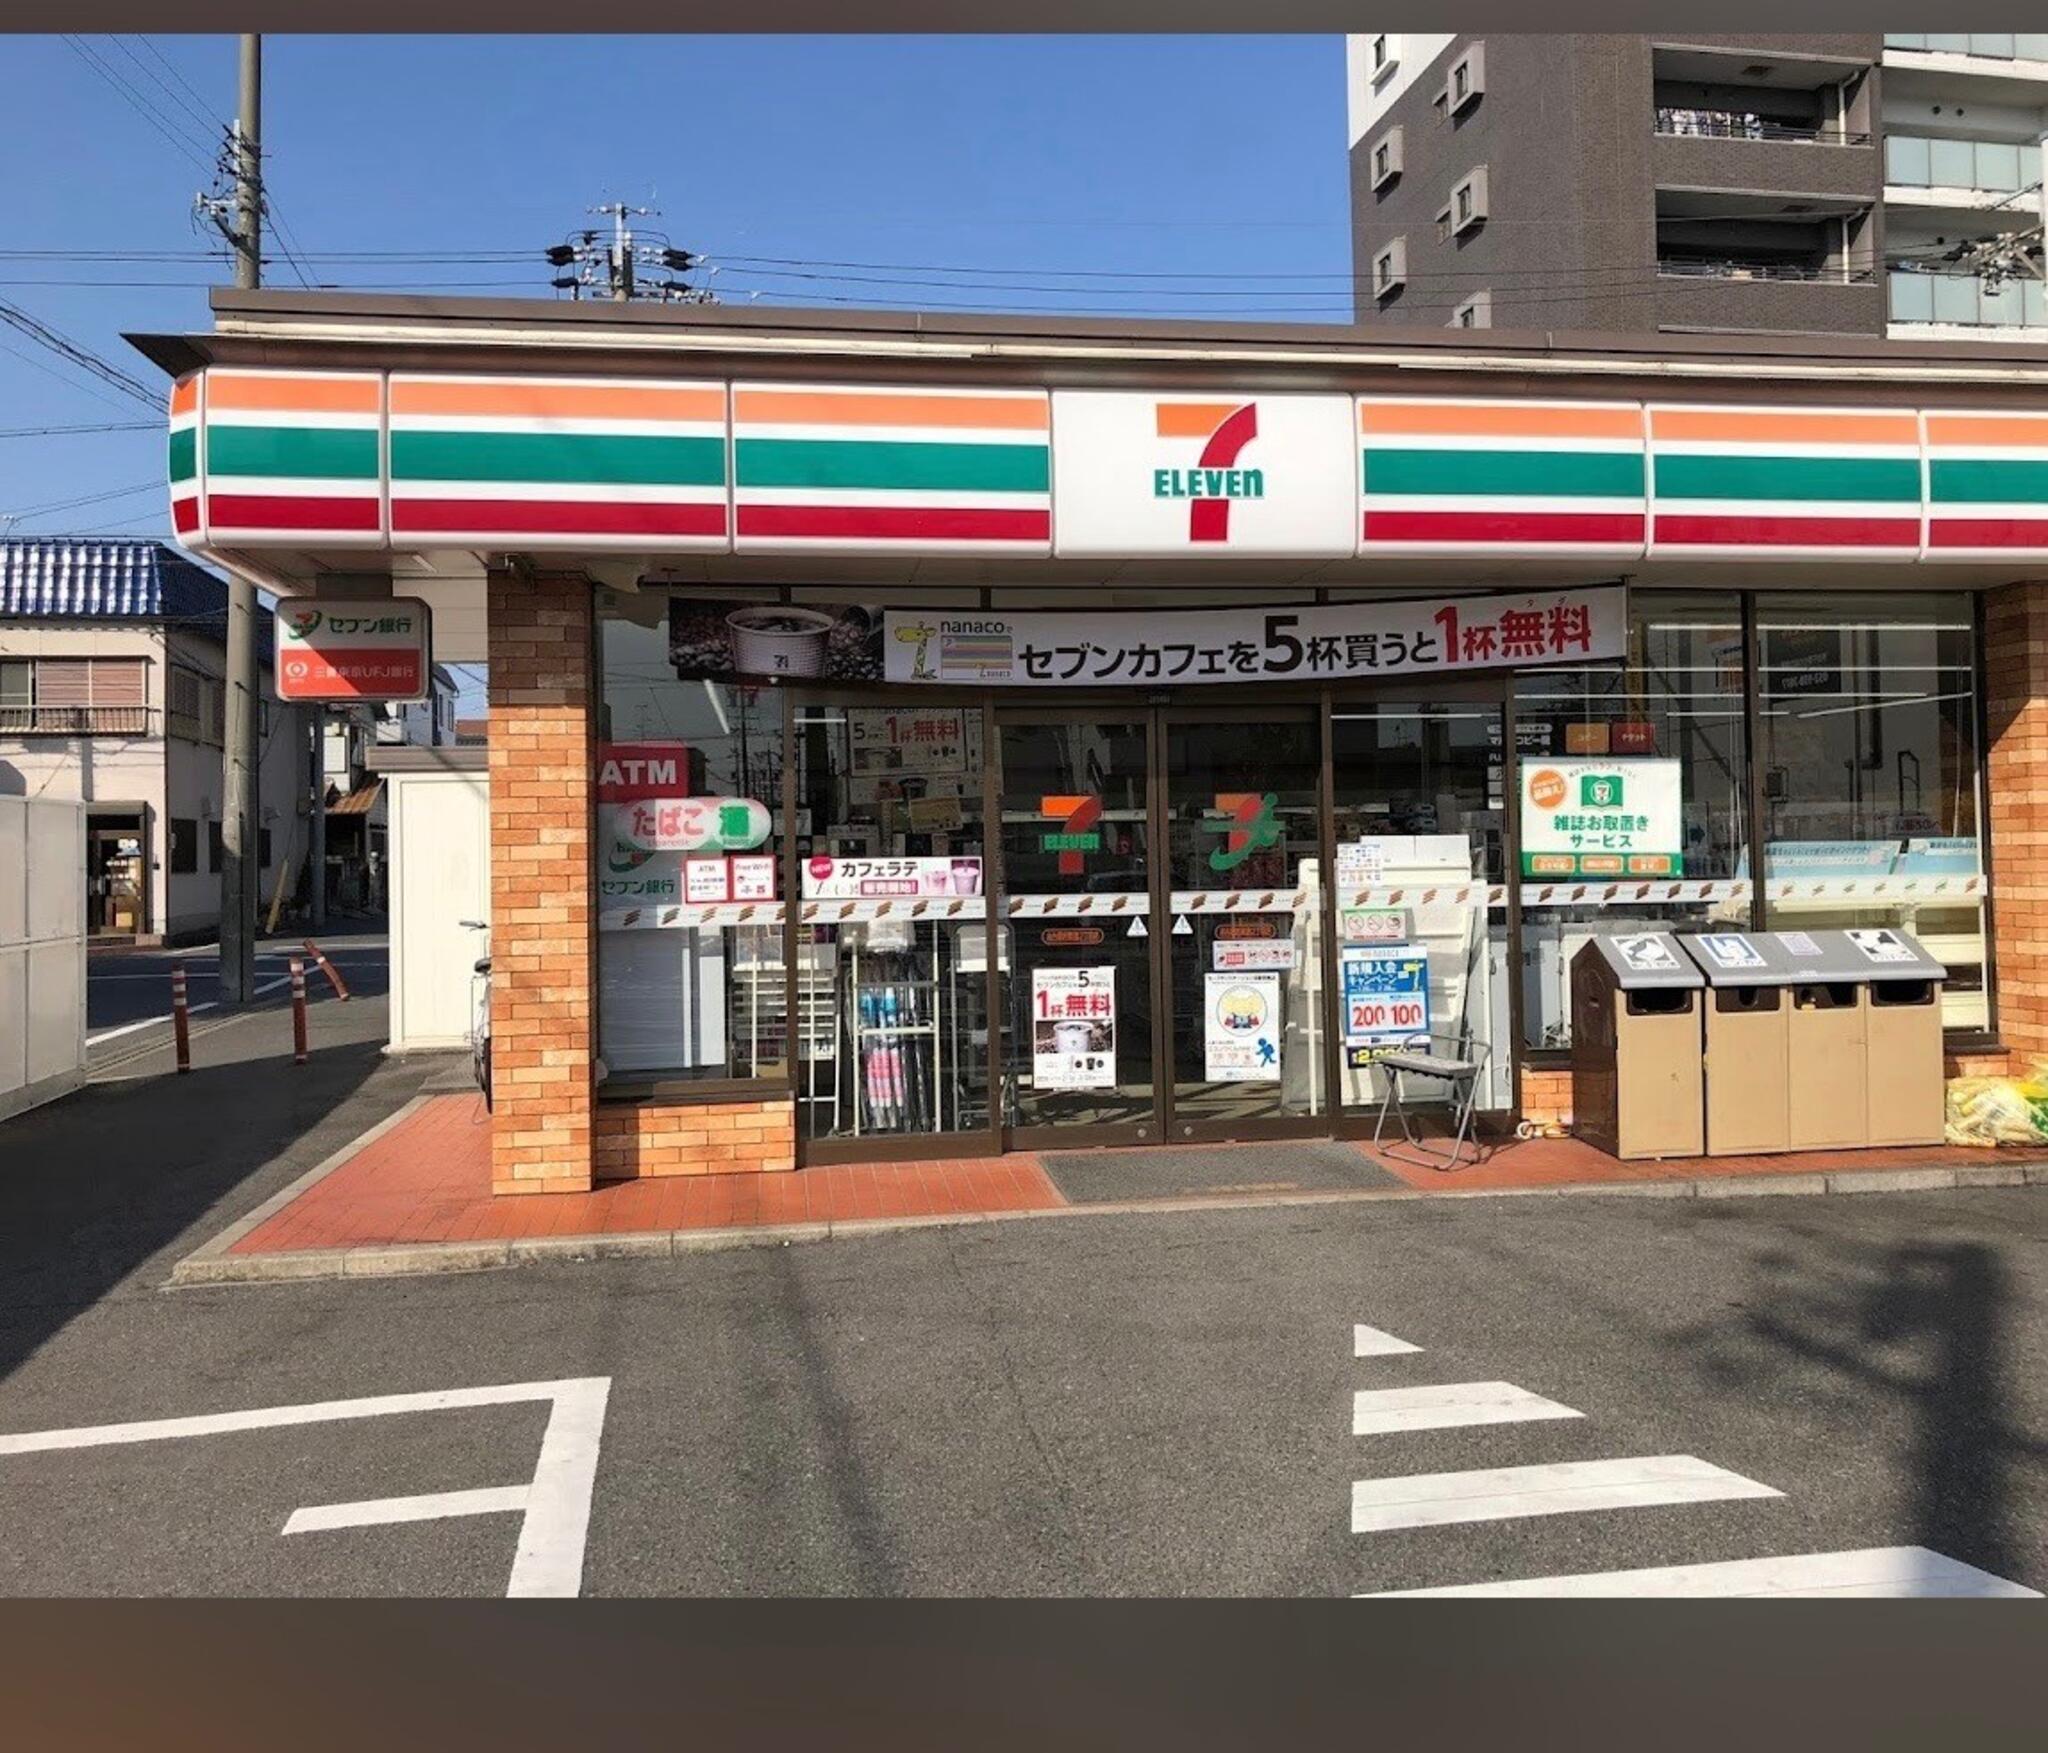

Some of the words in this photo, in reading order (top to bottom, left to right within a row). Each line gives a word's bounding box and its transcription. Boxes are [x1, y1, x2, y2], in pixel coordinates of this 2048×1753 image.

[328, 616, 412, 634] セブン銀行
[600, 759, 677, 785] ATM
[632, 805, 705, 837] たばこ
[1554, 815, 1649, 832] 雑誌お取置き
[1569, 834, 1633, 848] サービス
[841, 861, 919, 878] カフェラテ
[602, 878, 676, 896] セブン銀行
